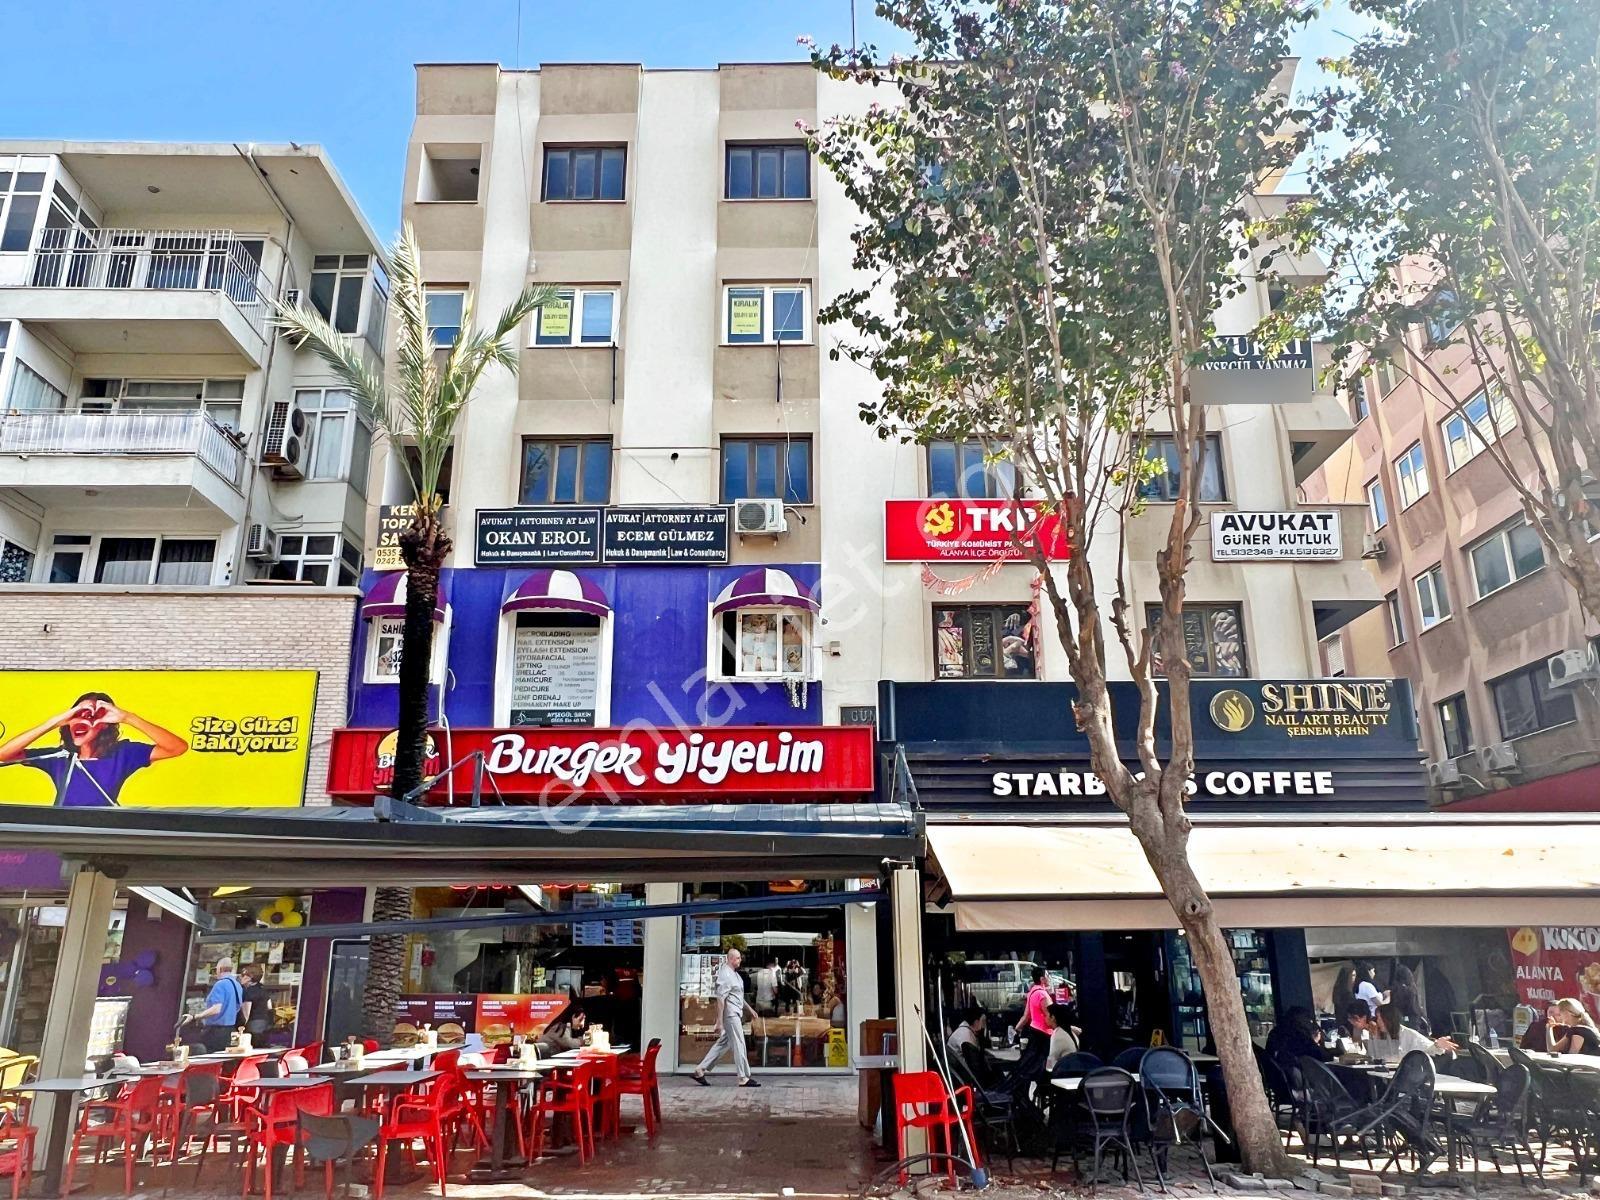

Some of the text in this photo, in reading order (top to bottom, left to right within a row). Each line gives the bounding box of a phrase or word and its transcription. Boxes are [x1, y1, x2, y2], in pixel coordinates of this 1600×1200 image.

[391, 505, 417, 516] KER
[481, 517, 595, 525] AVUKAT ATTORNEY AT LAW
[606, 514, 726, 523] AVUKAT ATTORNEY AT LAW
[966, 508, 1037, 532] TKP
[1221, 514, 1333, 531] AVUKAT
[381, 532, 403, 546] SA
[486, 531, 590, 545] OKAN EROL
[617, 529, 714, 541] ECEM GÜLMEZ
[1223, 533, 1332, 545] GÜNER KUTLUK
[926, 539, 960, 547] TÜRKİYE
[961, 539, 1002, 547] KOMÜNİST
[606, 548, 624, 557] Hukuk
[671, 548, 683, 556] Law
[684, 548, 688, 556] &
[690, 548, 726, 558] Consultancy
[970, 548, 987, 558] İLÇE
[375, 557, 396, 565] 0242
[1261, 683, 1391, 713] SHINE
[190, 716, 298, 735] Size Güzel
[1265, 714, 1389, 725] NAIL ART BEAUTY
[1287, 725, 1369, 738] ŞEBNEM ŞAHİN
[191, 734, 298, 755] Bakıyoruz
[992, 771, 1198, 796] STARBS
[1205, 771, 1334, 796] COFFEE
[1516, 966, 1563, 981] ALANYA
